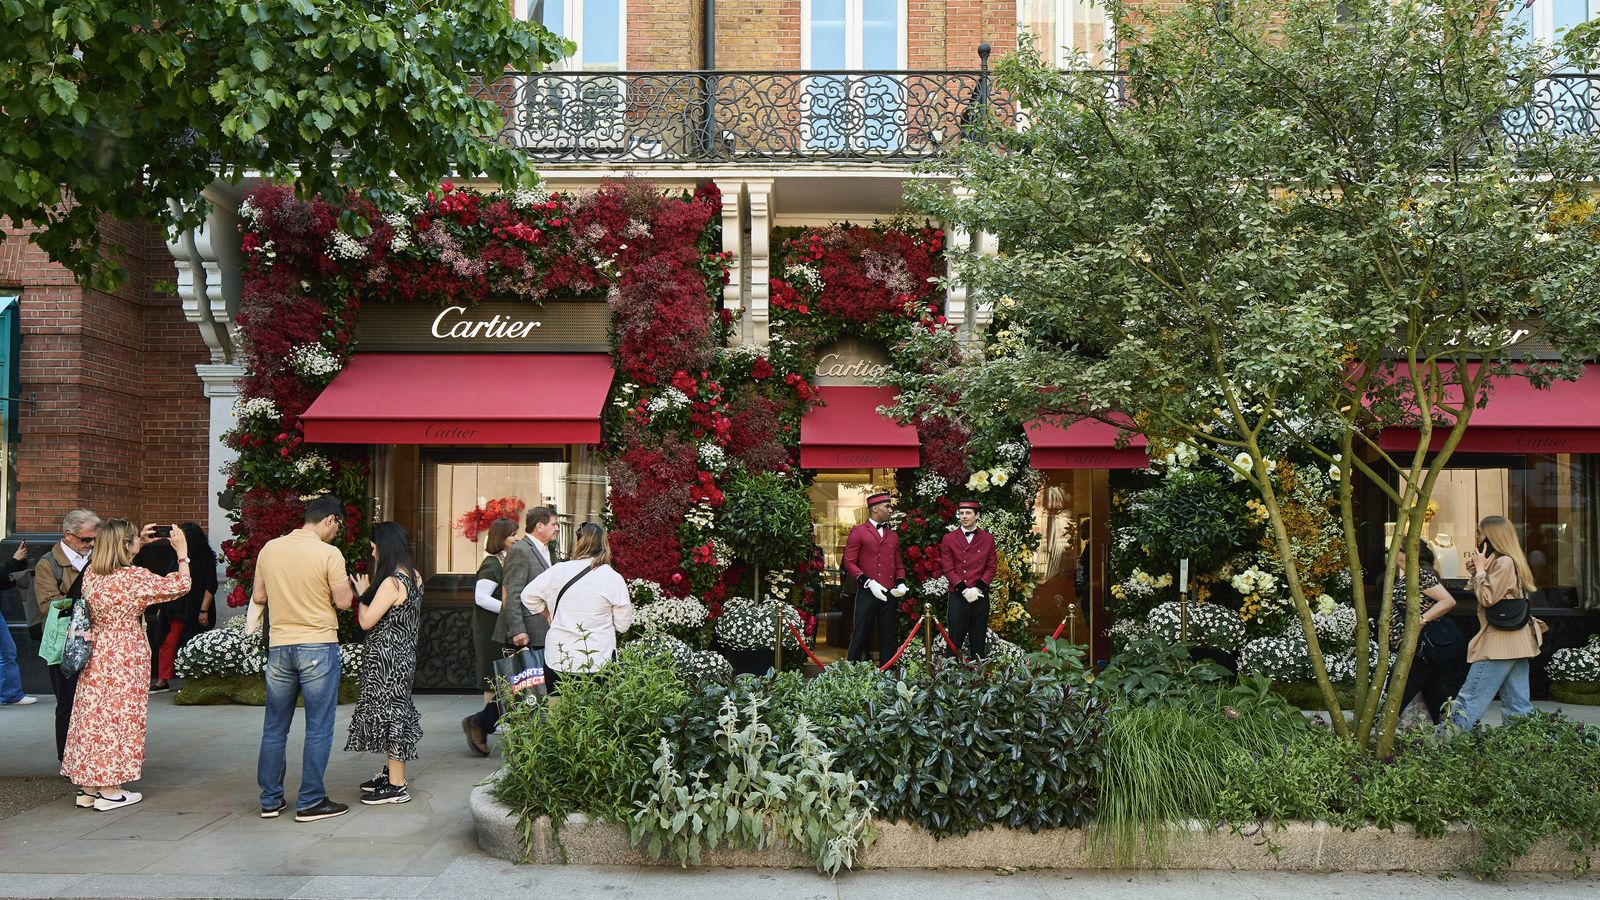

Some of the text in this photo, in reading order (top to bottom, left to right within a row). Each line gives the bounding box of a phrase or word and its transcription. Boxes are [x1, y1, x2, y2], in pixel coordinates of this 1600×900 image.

[431, 306, 541, 338] Cartier
[425, 423, 478, 439] Cartier
[1516, 431, 1567, 448] Cartier
[834, 448, 881, 463] Cartier
[513, 667, 545, 684] SPORTS
[514, 675, 545, 692] DIRECT
